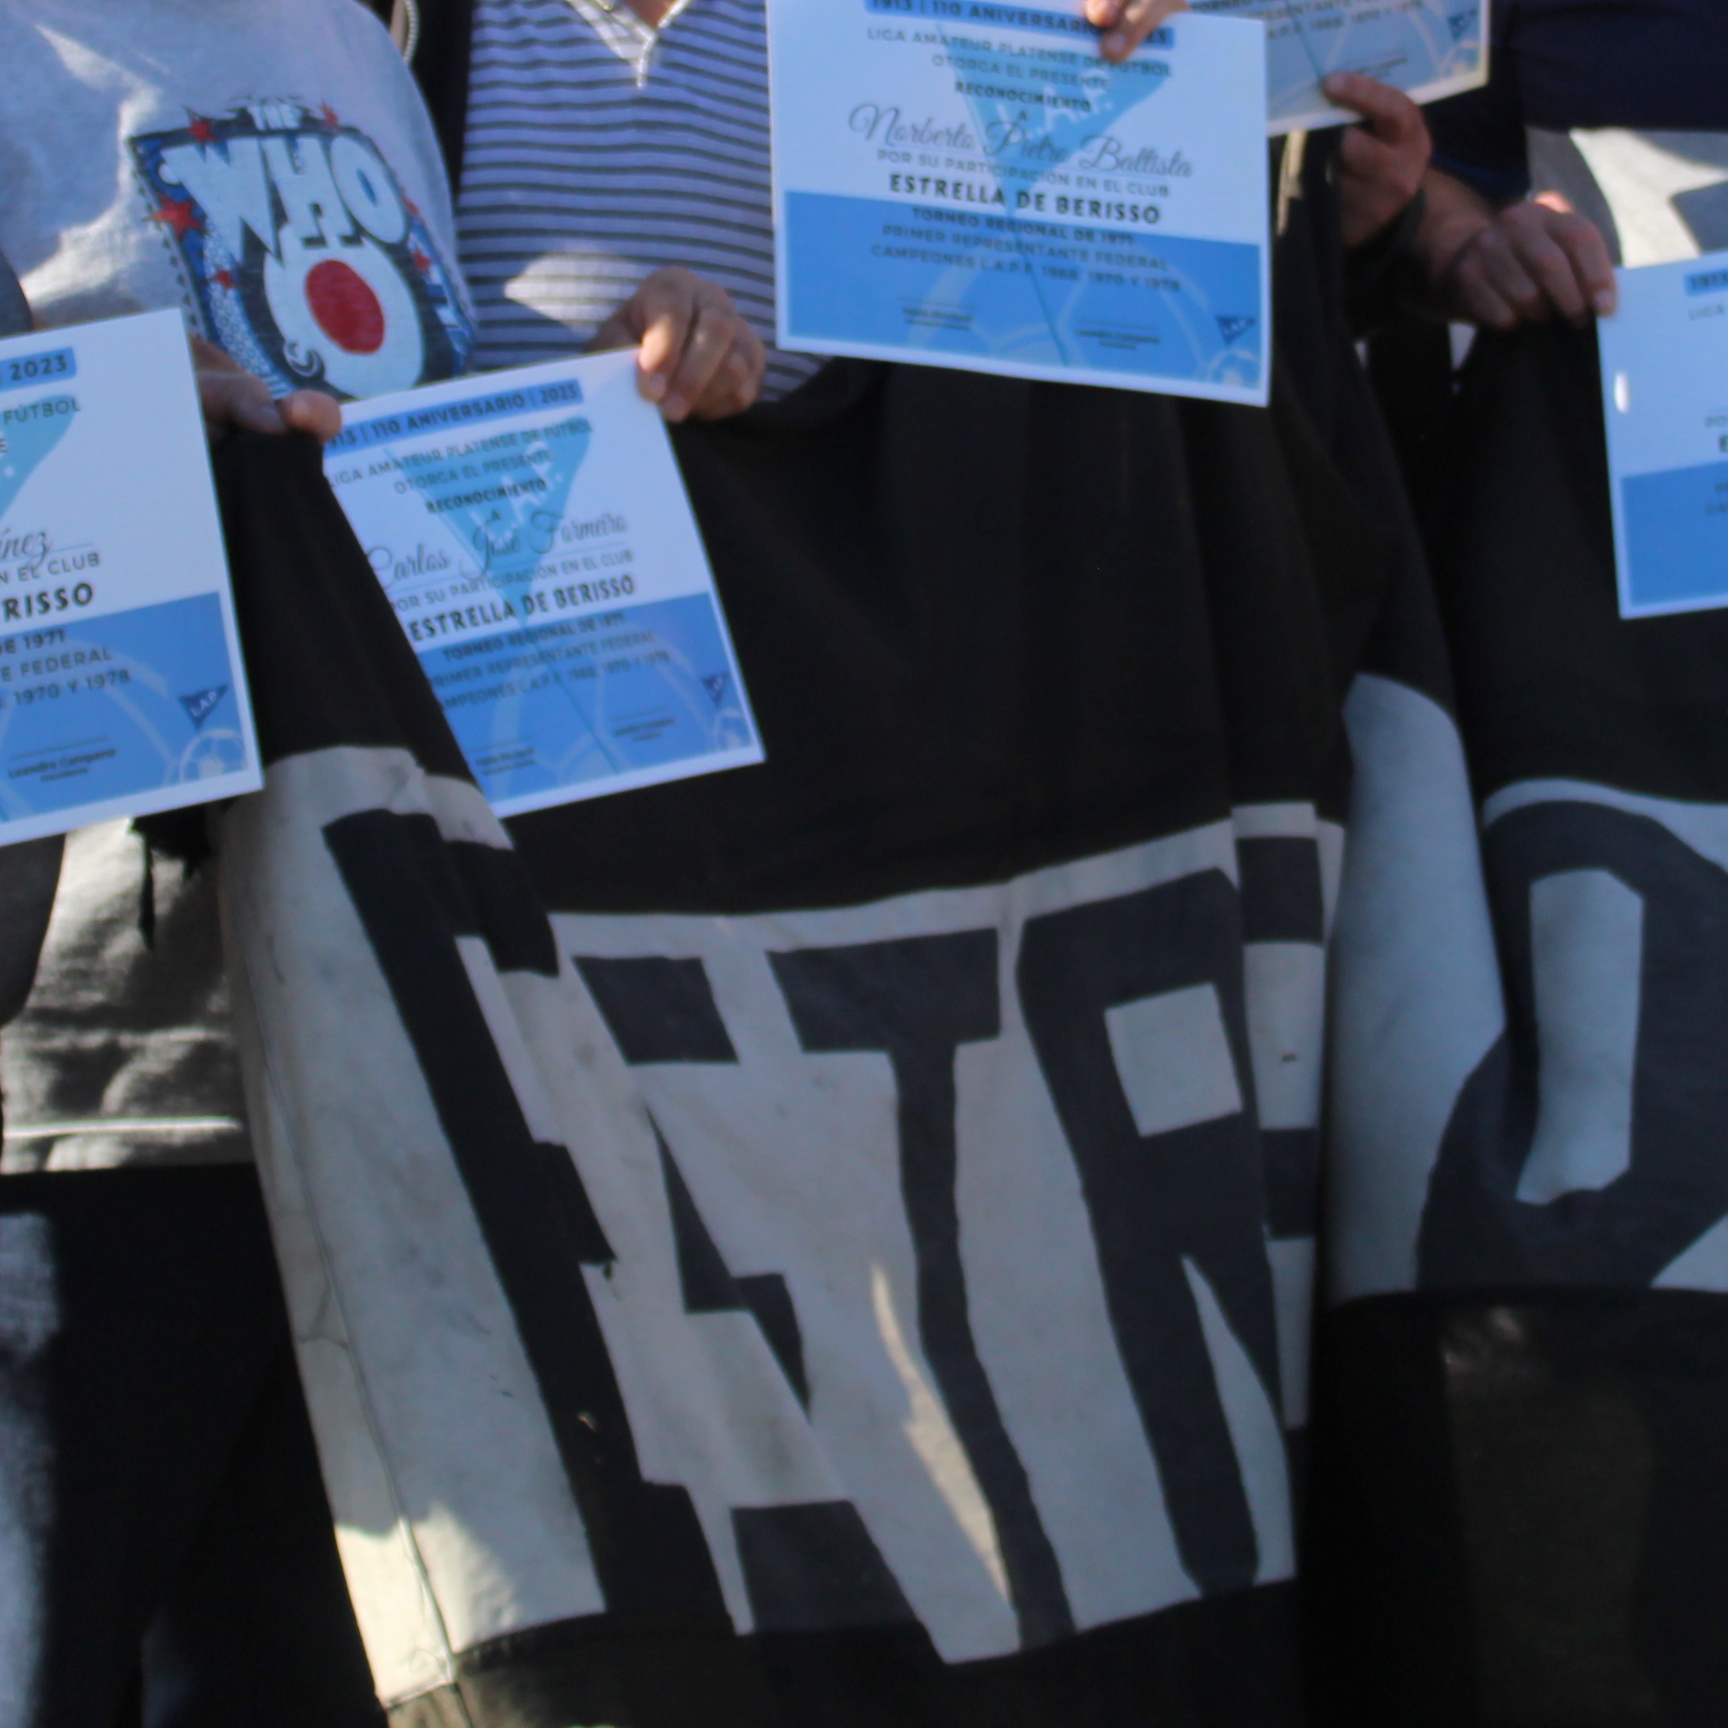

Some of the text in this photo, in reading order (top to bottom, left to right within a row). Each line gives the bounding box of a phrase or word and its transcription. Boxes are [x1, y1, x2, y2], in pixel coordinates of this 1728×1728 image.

[912, 29, 993, 53] AMATEUR
[997, 42, 1080, 66] PLATENSE
[932, 52, 1000, 75] OTORGA
[1005, 62, 1024, 78] EL
[953, 79, 1094, 113] RECONOCIMIENTO
[878, 147, 911, 165] POR
[918, 152, 940, 168] SU
[1075, 174, 1098, 190] EN
[1103, 178, 1121, 194] EL
[1126, 179, 1169, 198] CLUB
[158, 135, 409, 270] WHO
[890, 171, 1161, 227] ESTRELLA DE BERISSO
[8, 352, 69, 382] 2023
[371, 418, 401, 438] 110
[405, 393, 526, 429] ANIVERSARIO
[423, 478, 550, 515] RECONOCIMIENTO
[17, 561, 42, 583] EL
[45, 549, 102, 576] CLUB
[423, 586, 447, 604] SU
[558, 558, 582, 575] EN
[581, 555, 600, 571] EL
[596, 547, 635, 568] CLUB
[405, 573, 638, 642] ESTRELLA DE BERISSO
[21, 626, 68, 651] 1971
[19, 644, 113, 679] FEDERAL
[13, 681, 62, 707] 1970
[64, 677, 80, 696] Y
[84, 665, 132, 691] 1978
